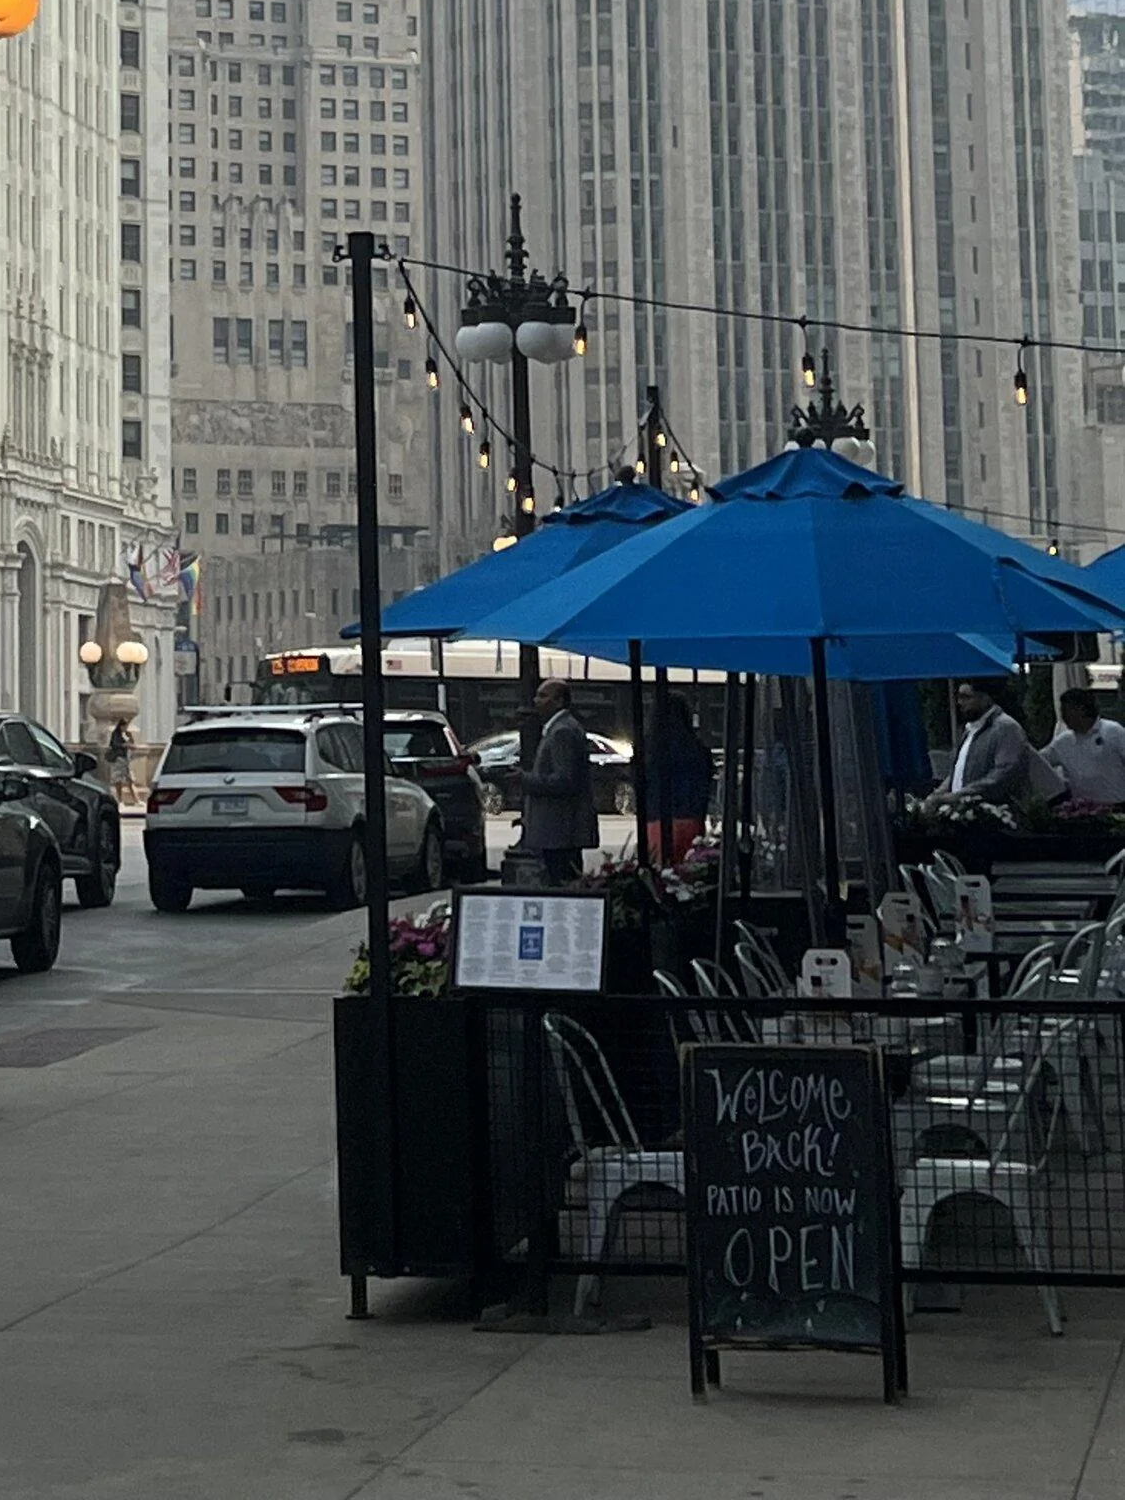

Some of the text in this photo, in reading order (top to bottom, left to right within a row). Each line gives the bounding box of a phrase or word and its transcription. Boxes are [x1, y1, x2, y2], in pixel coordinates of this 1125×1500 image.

[742, 1123, 841, 1177] BACK!
[707, 1184, 856, 1217] PATIO IS NOW
[724, 1223, 855, 1294] OPEN
